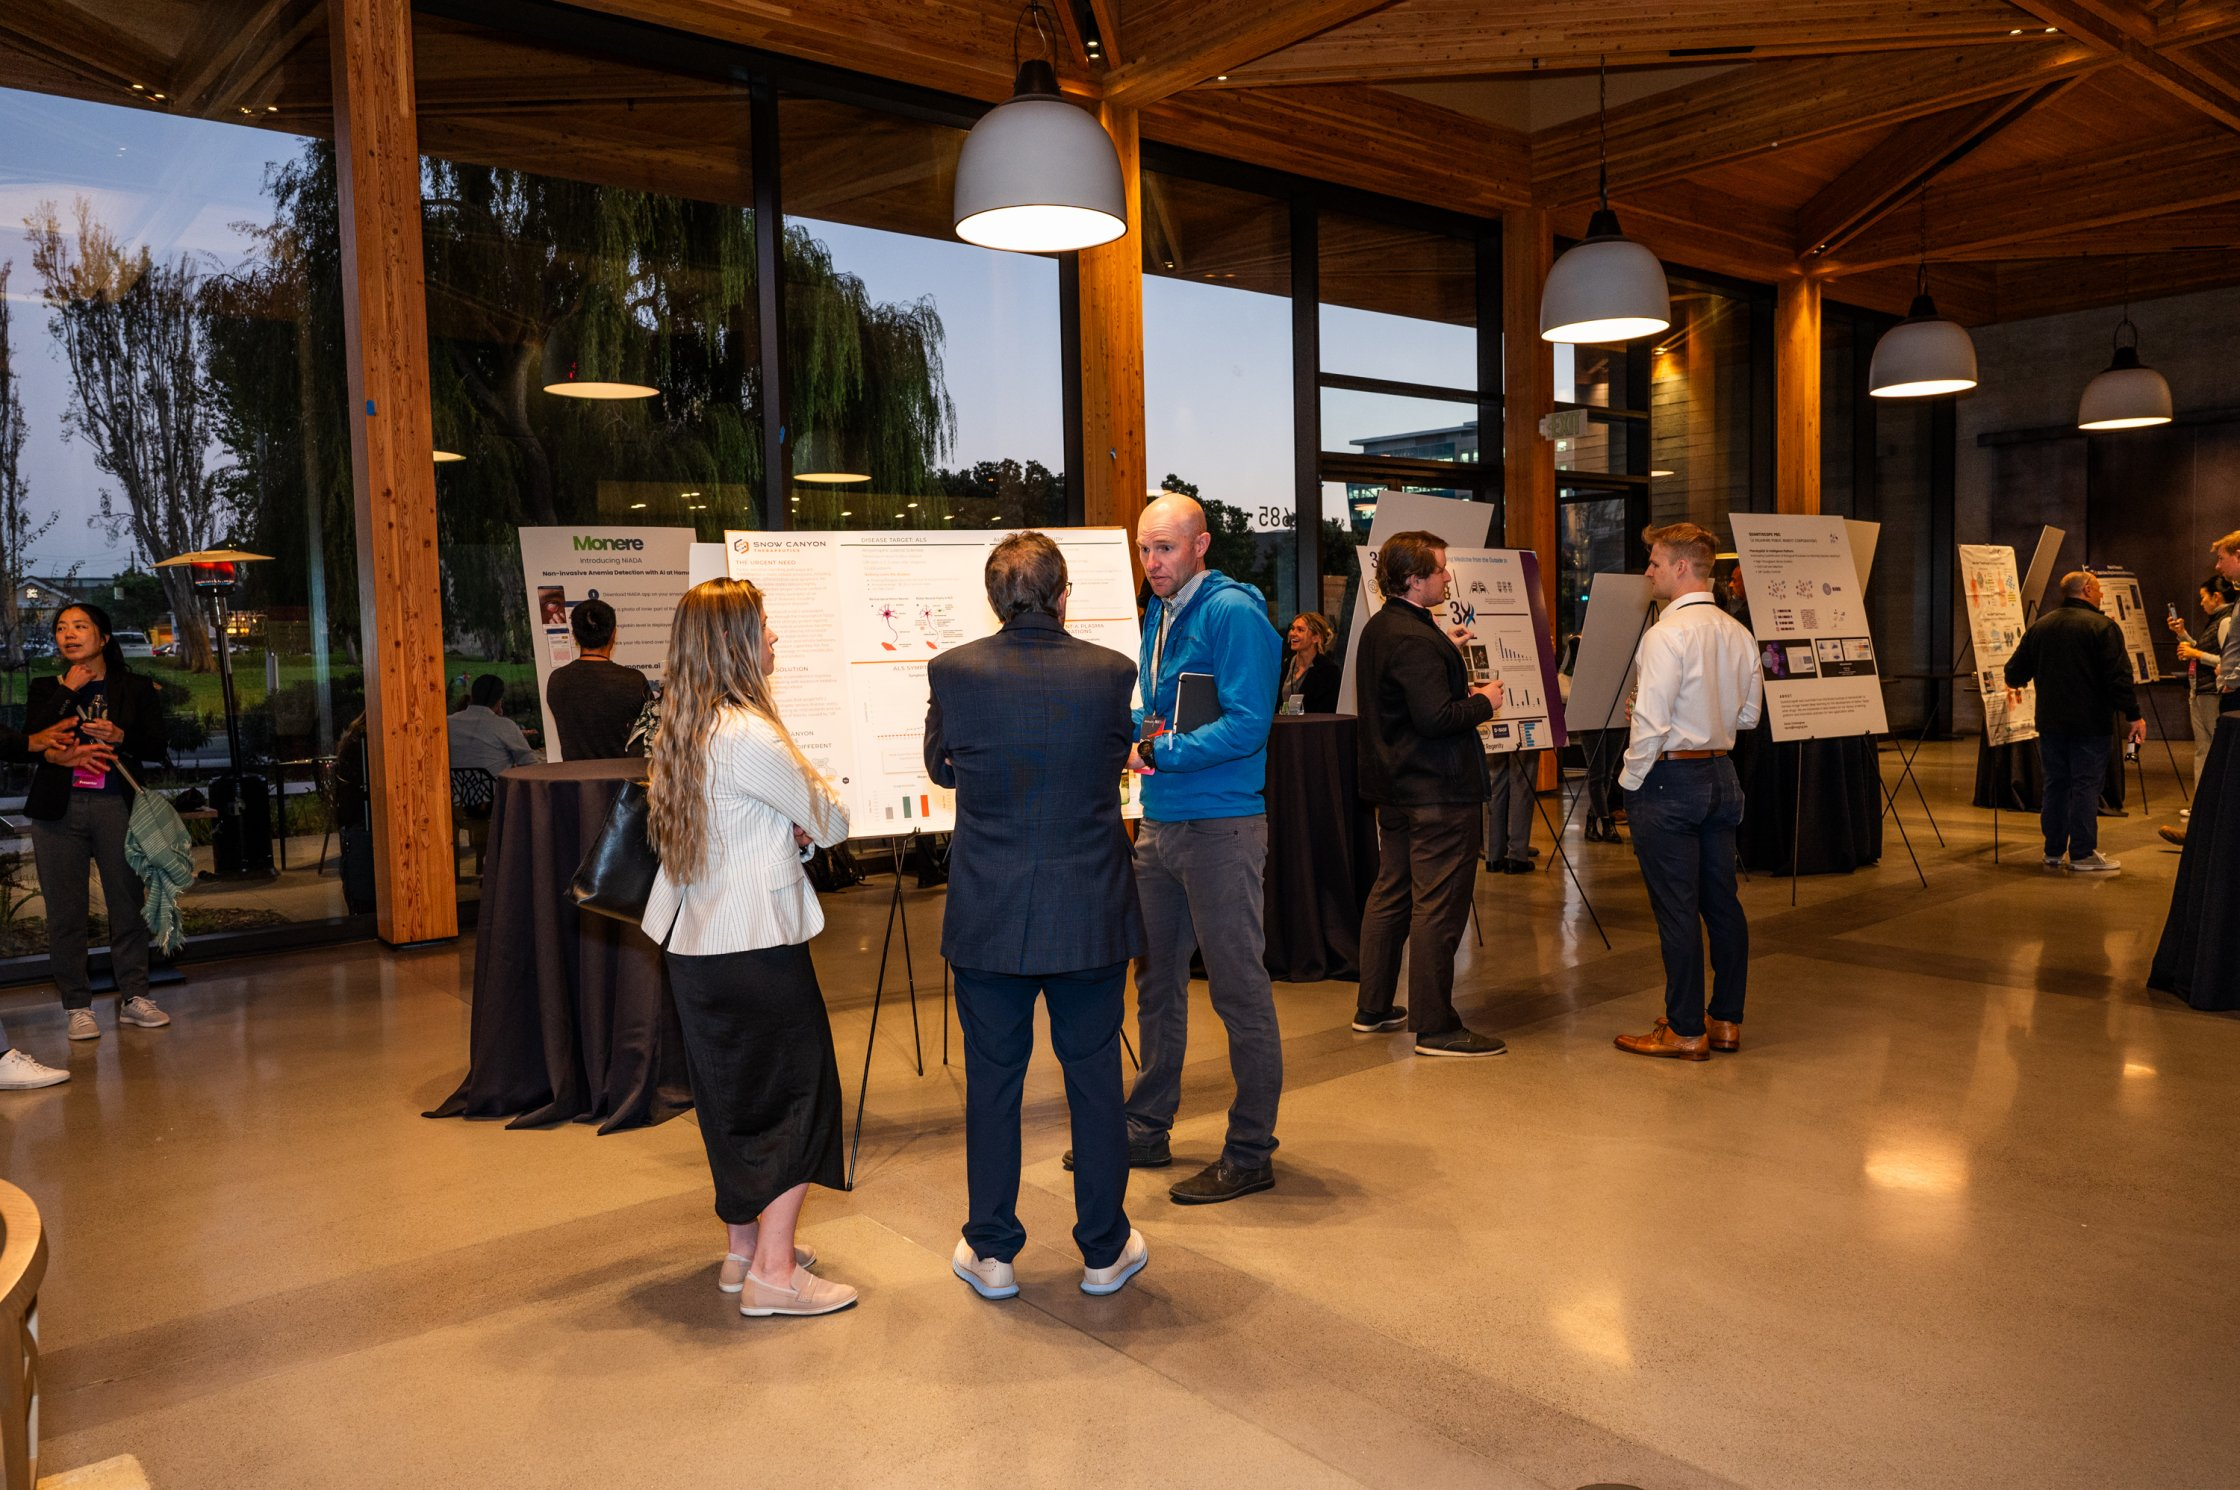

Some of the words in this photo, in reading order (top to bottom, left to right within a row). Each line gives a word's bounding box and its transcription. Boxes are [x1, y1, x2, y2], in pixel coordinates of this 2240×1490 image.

[1551, 411, 1581, 439] EXIT
[572, 535, 644, 551] Monere
[580, 557, 621, 565] Introducing
